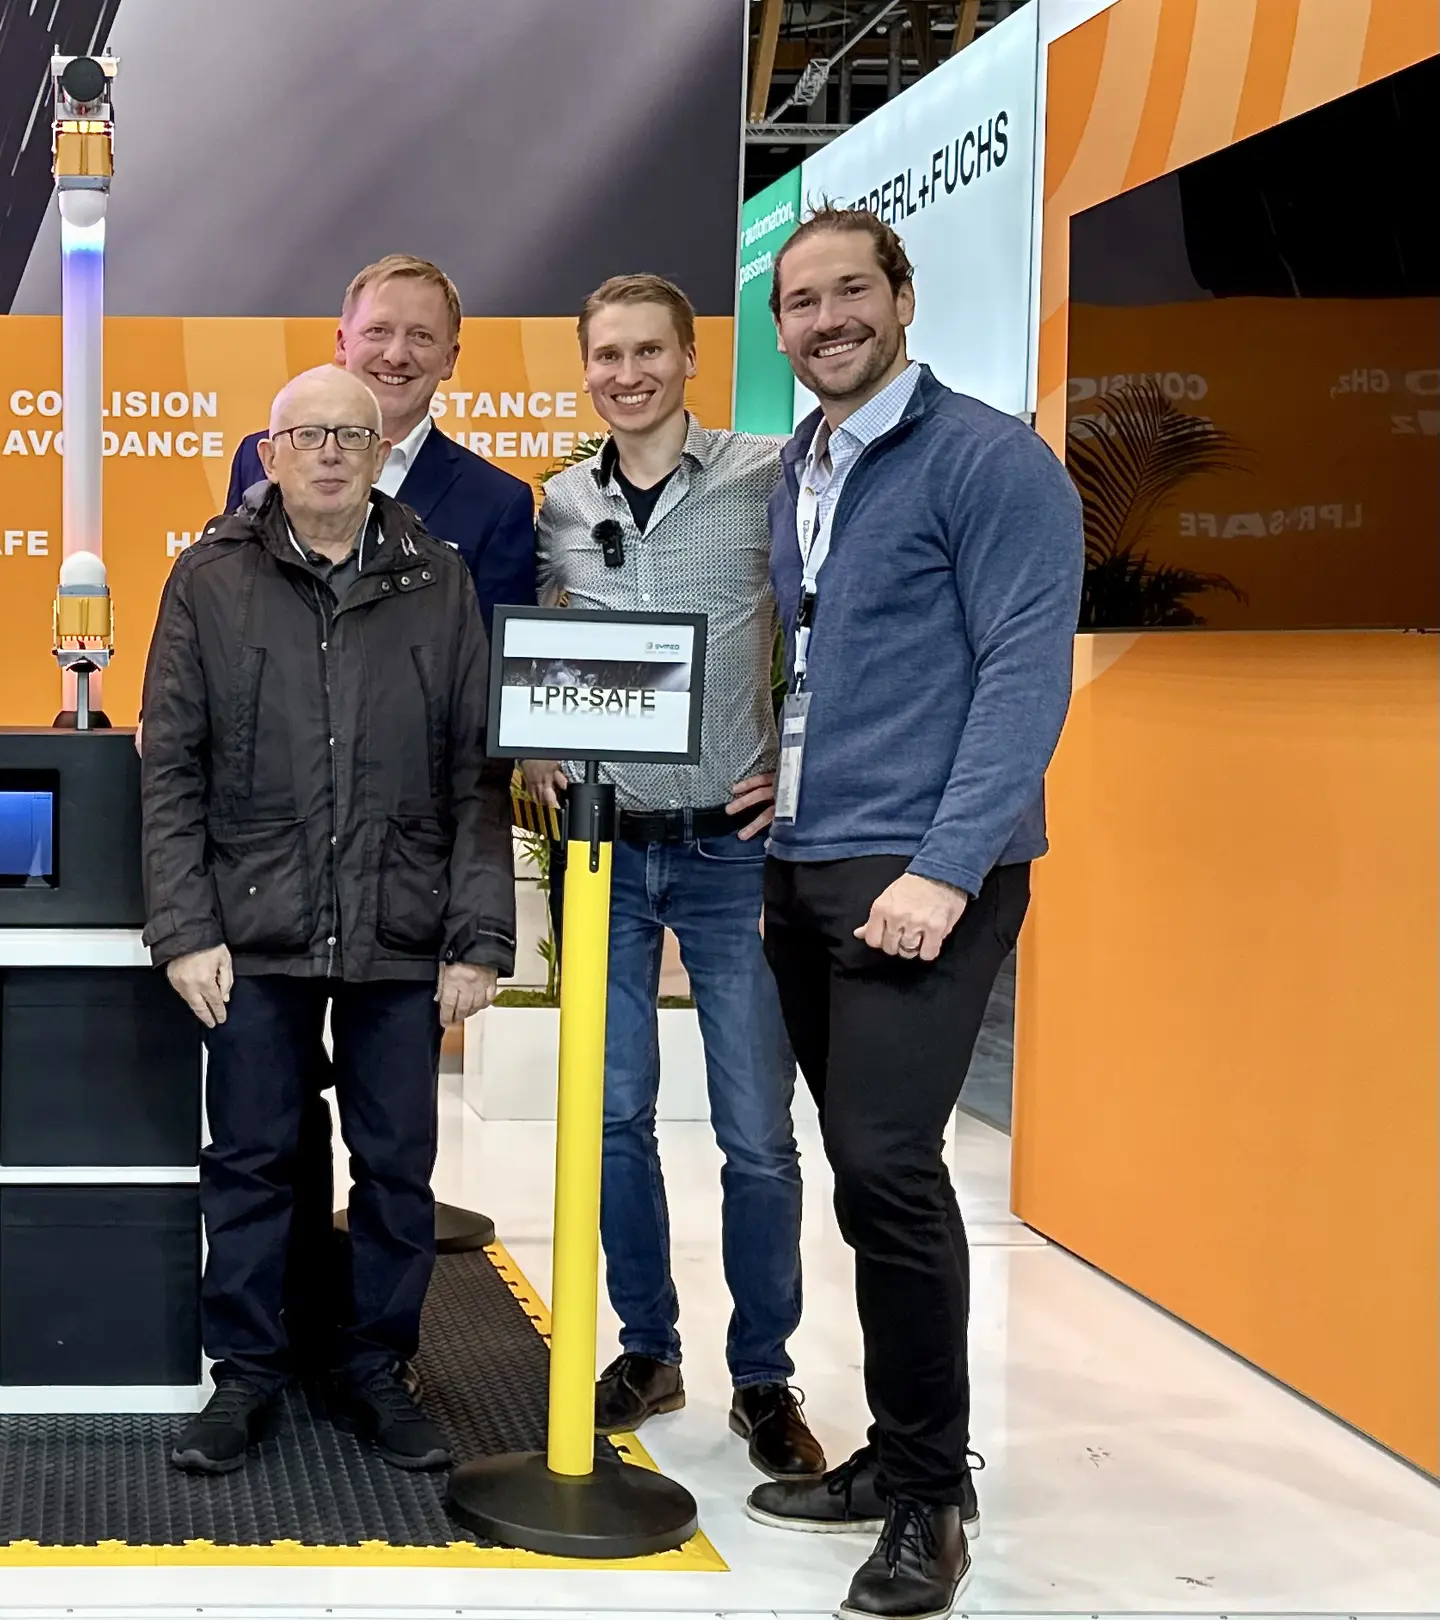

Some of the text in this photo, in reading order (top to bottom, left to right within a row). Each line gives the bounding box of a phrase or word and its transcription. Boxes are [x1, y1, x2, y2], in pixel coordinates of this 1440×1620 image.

[847, 110, 1009, 226] PERL+FUCHS
[10, 390, 217, 418] COISION
[430, 391, 577, 418] STANCE
[2, 430, 224, 457] AVDANCE
[529, 685, 656, 709] LPR-SAFE
